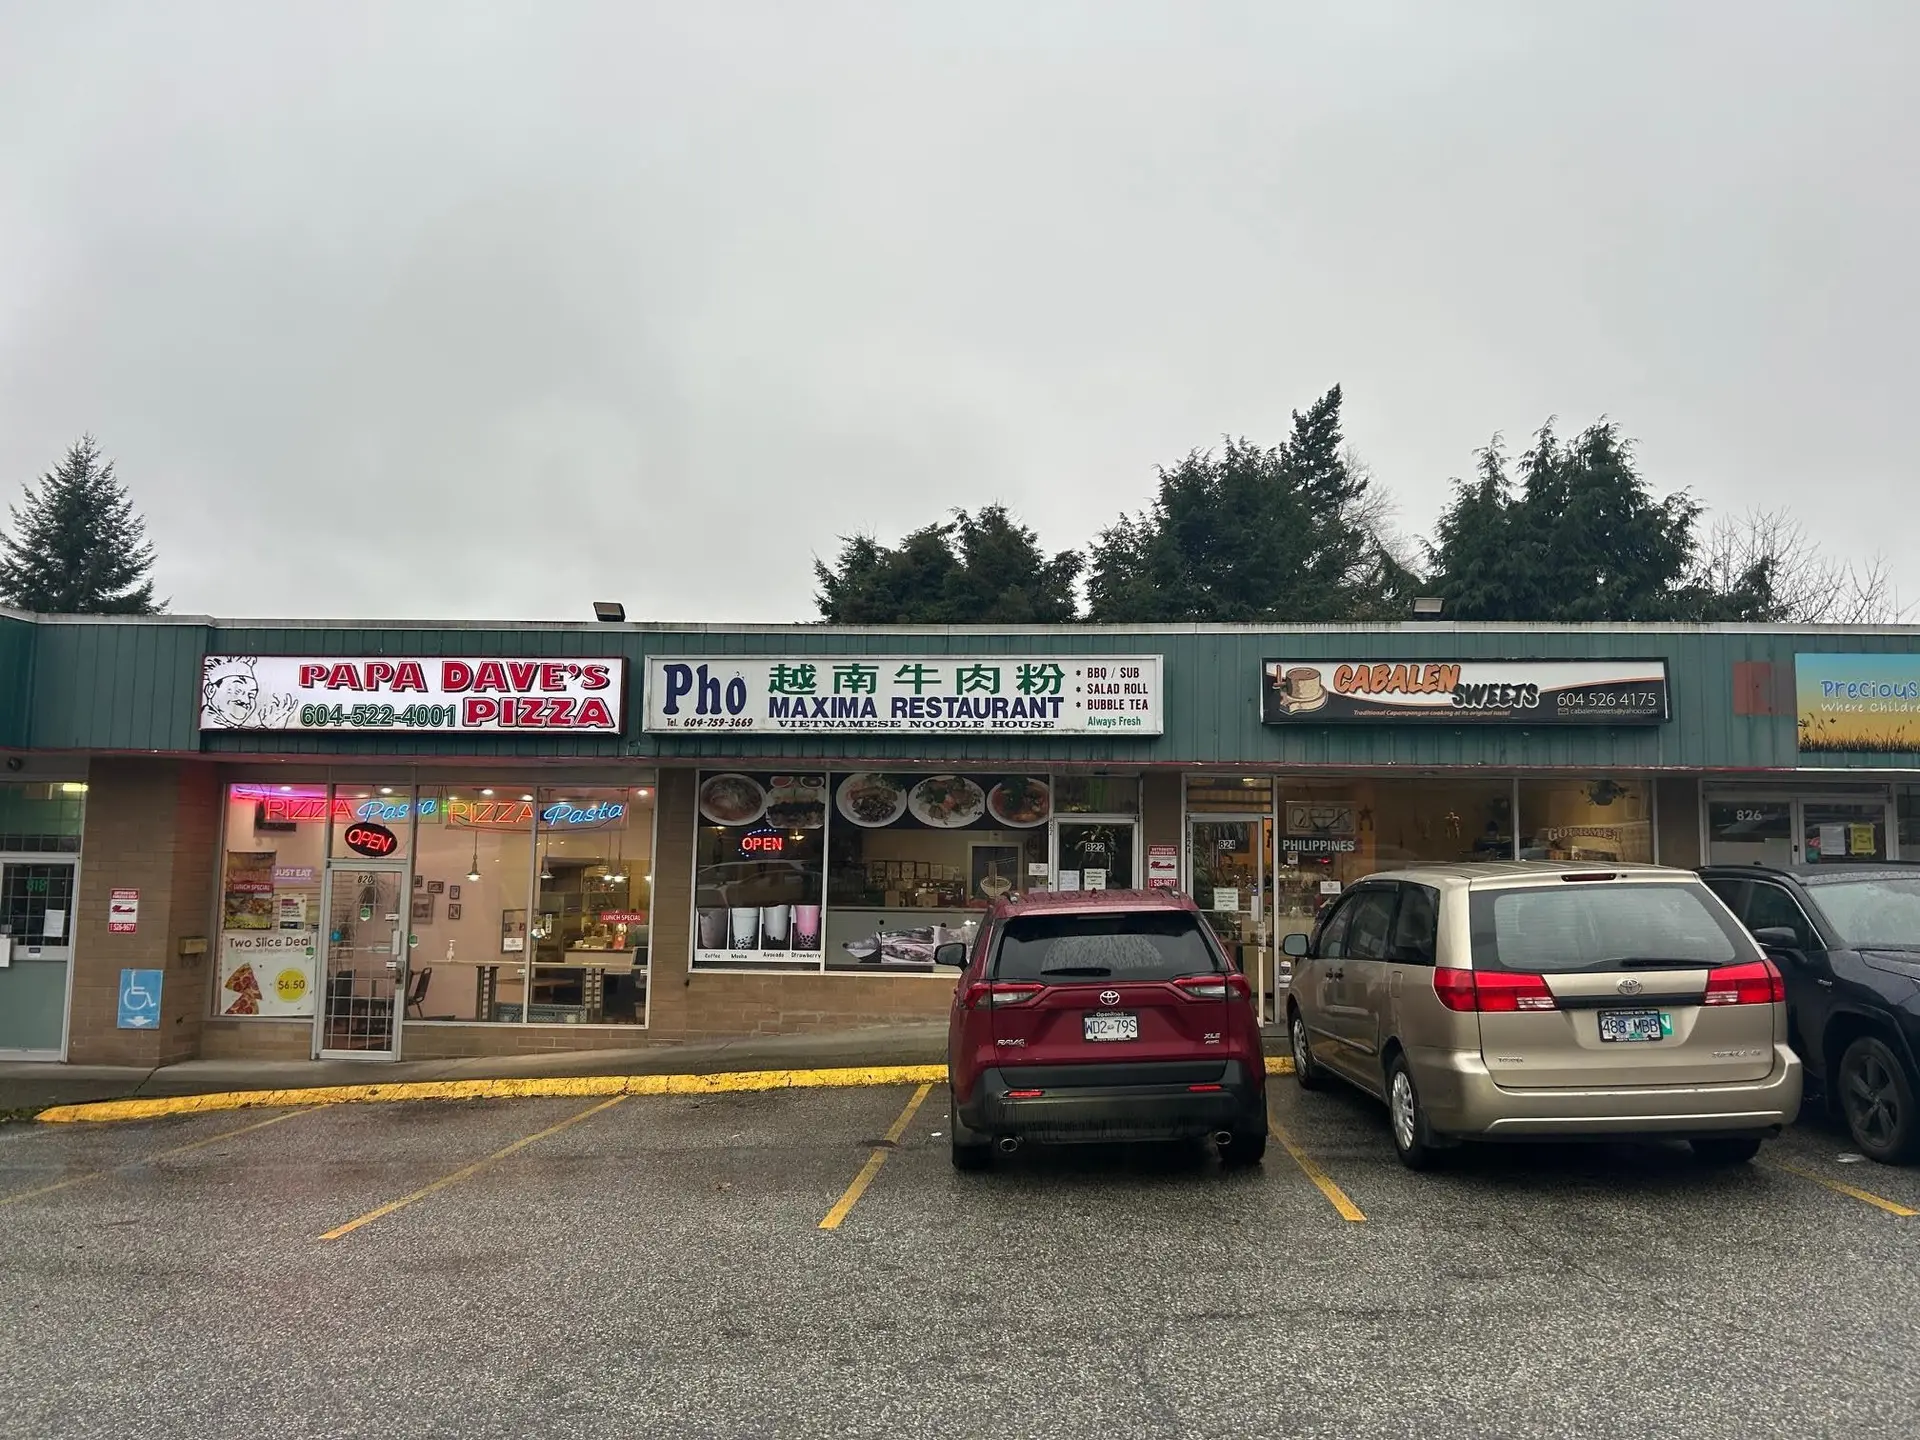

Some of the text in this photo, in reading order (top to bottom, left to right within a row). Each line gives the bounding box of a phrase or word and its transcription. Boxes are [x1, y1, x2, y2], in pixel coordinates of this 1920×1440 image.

[300, 661, 610, 693] PAPA DAVE'S
[768, 662, 1066, 697] 越南牛肉粉
[1087, 667, 1107, 680] BBQ
[1120, 667, 1140, 680] SUB
[1087, 683, 1149, 696] SALAD ROLL
[1333, 663, 1540, 710] CABALEN SWEETS
[1821, 680, 1918, 699] Precious
[1087, 699, 1149, 712] BUBBLE TEA
[1557, 692, 1657, 707] 604 526 4175
[300, 697, 618, 730] 604-522-4001 PIZZA
[769, 696, 1064, 720] MAXIMA RESTAURANT
[1821, 701, 1864, 713] Where
[684, 717, 754, 728] 604-759-3669
[779, 720, 1055, 730] VIETNAMESE NOODLE HOUSE
[1087, 715, 1141, 728] Always Fresh
[543, 802, 624, 825] Pasta
[1736, 809, 1763, 821] 826
[1548, 826, 1620, 841] GOURMET
[347, 829, 392, 852] OPEN
[741, 837, 783, 851] OPEN
[1086, 842, 1105, 852] 822
[1219, 840, 1236, 850] 824
[1282, 839, 1355, 852] PHILIPPINES
[275, 868, 295, 877] JUST
[296, 868, 312, 877] EAT
[357, 875, 374, 884] 820
[229, 936, 312, 948] Two Slice Deal
[278, 980, 305, 990] $6.50
[997, 1038, 1025, 1047] RAV4
